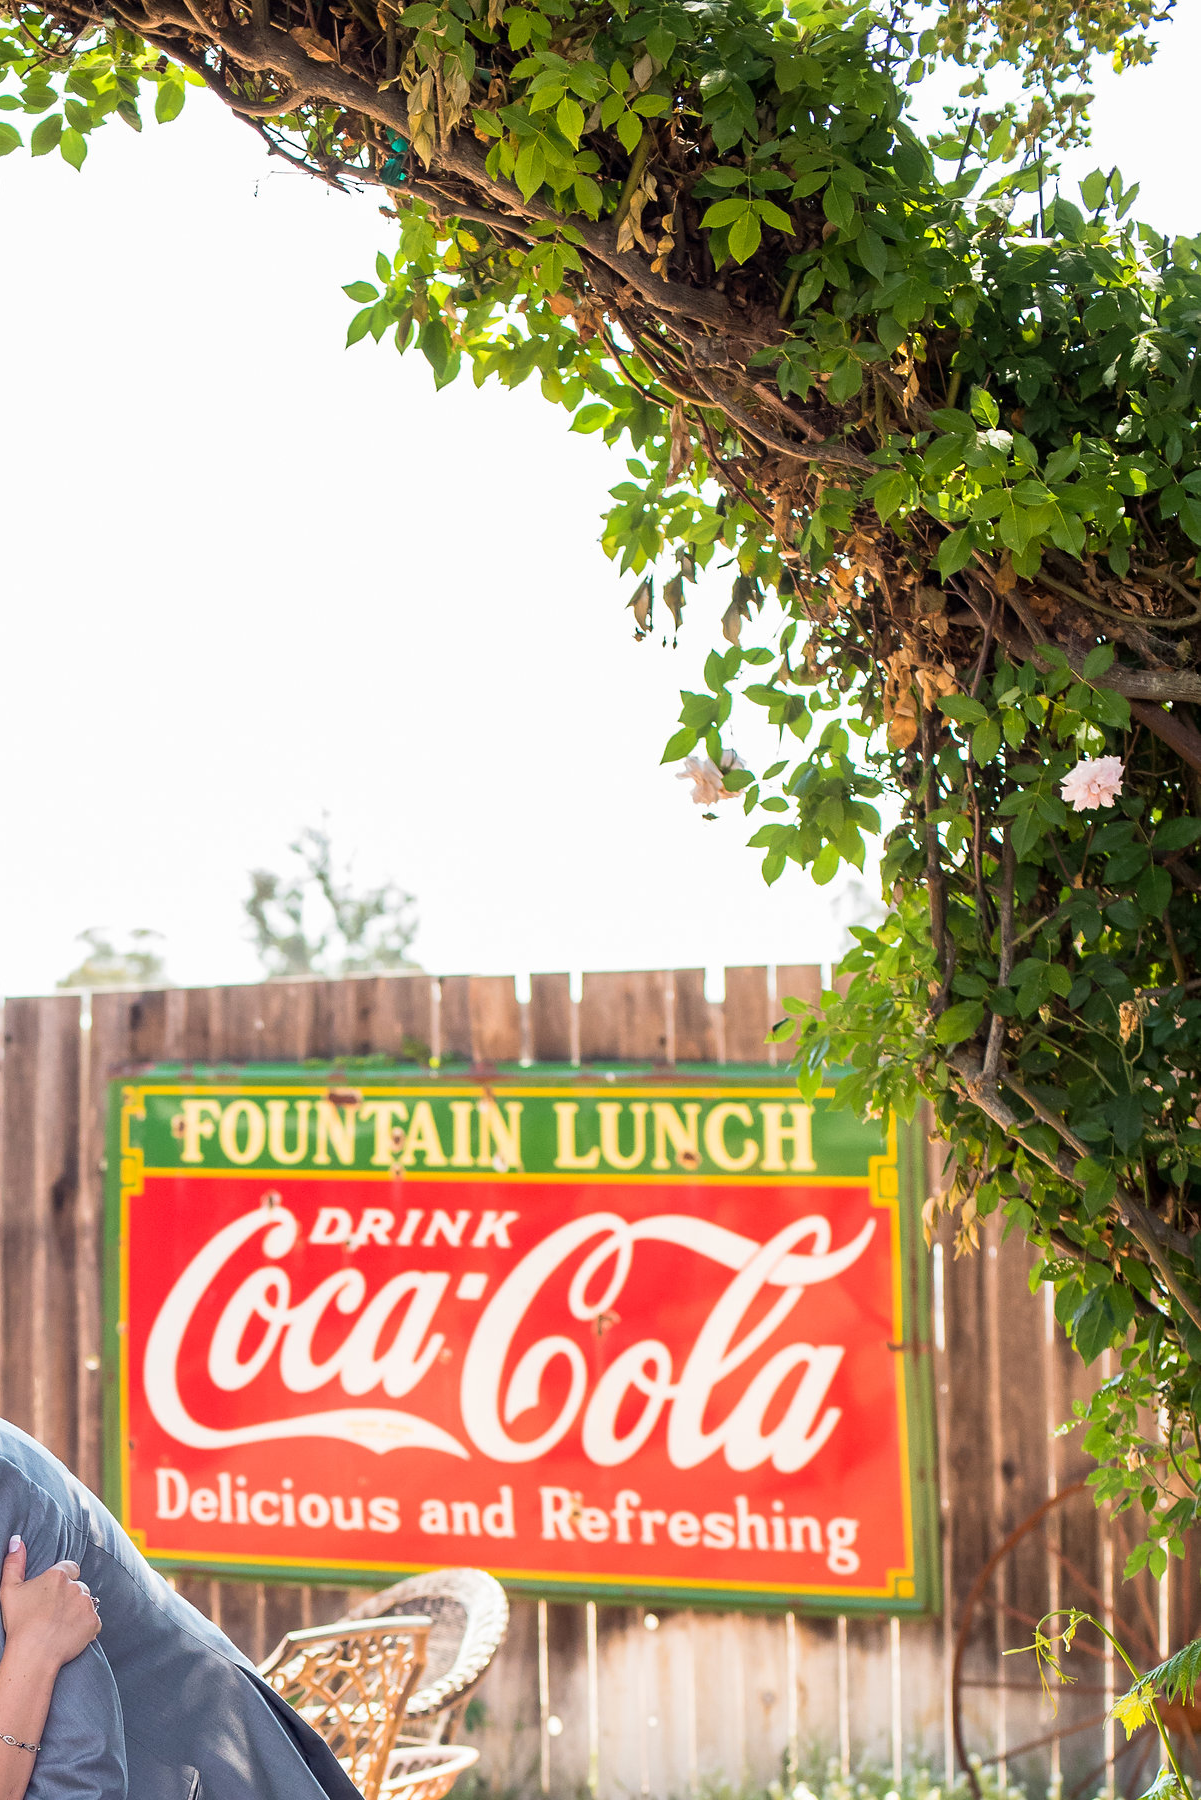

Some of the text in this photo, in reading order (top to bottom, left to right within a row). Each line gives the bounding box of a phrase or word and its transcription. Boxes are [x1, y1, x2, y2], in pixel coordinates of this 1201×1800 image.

[180, 1099, 817, 1172] FOUNTAIN LUNCH
[308, 1207, 521, 1248] DRINK
[154, 1467, 861, 1576] Delicious and Refreshing
